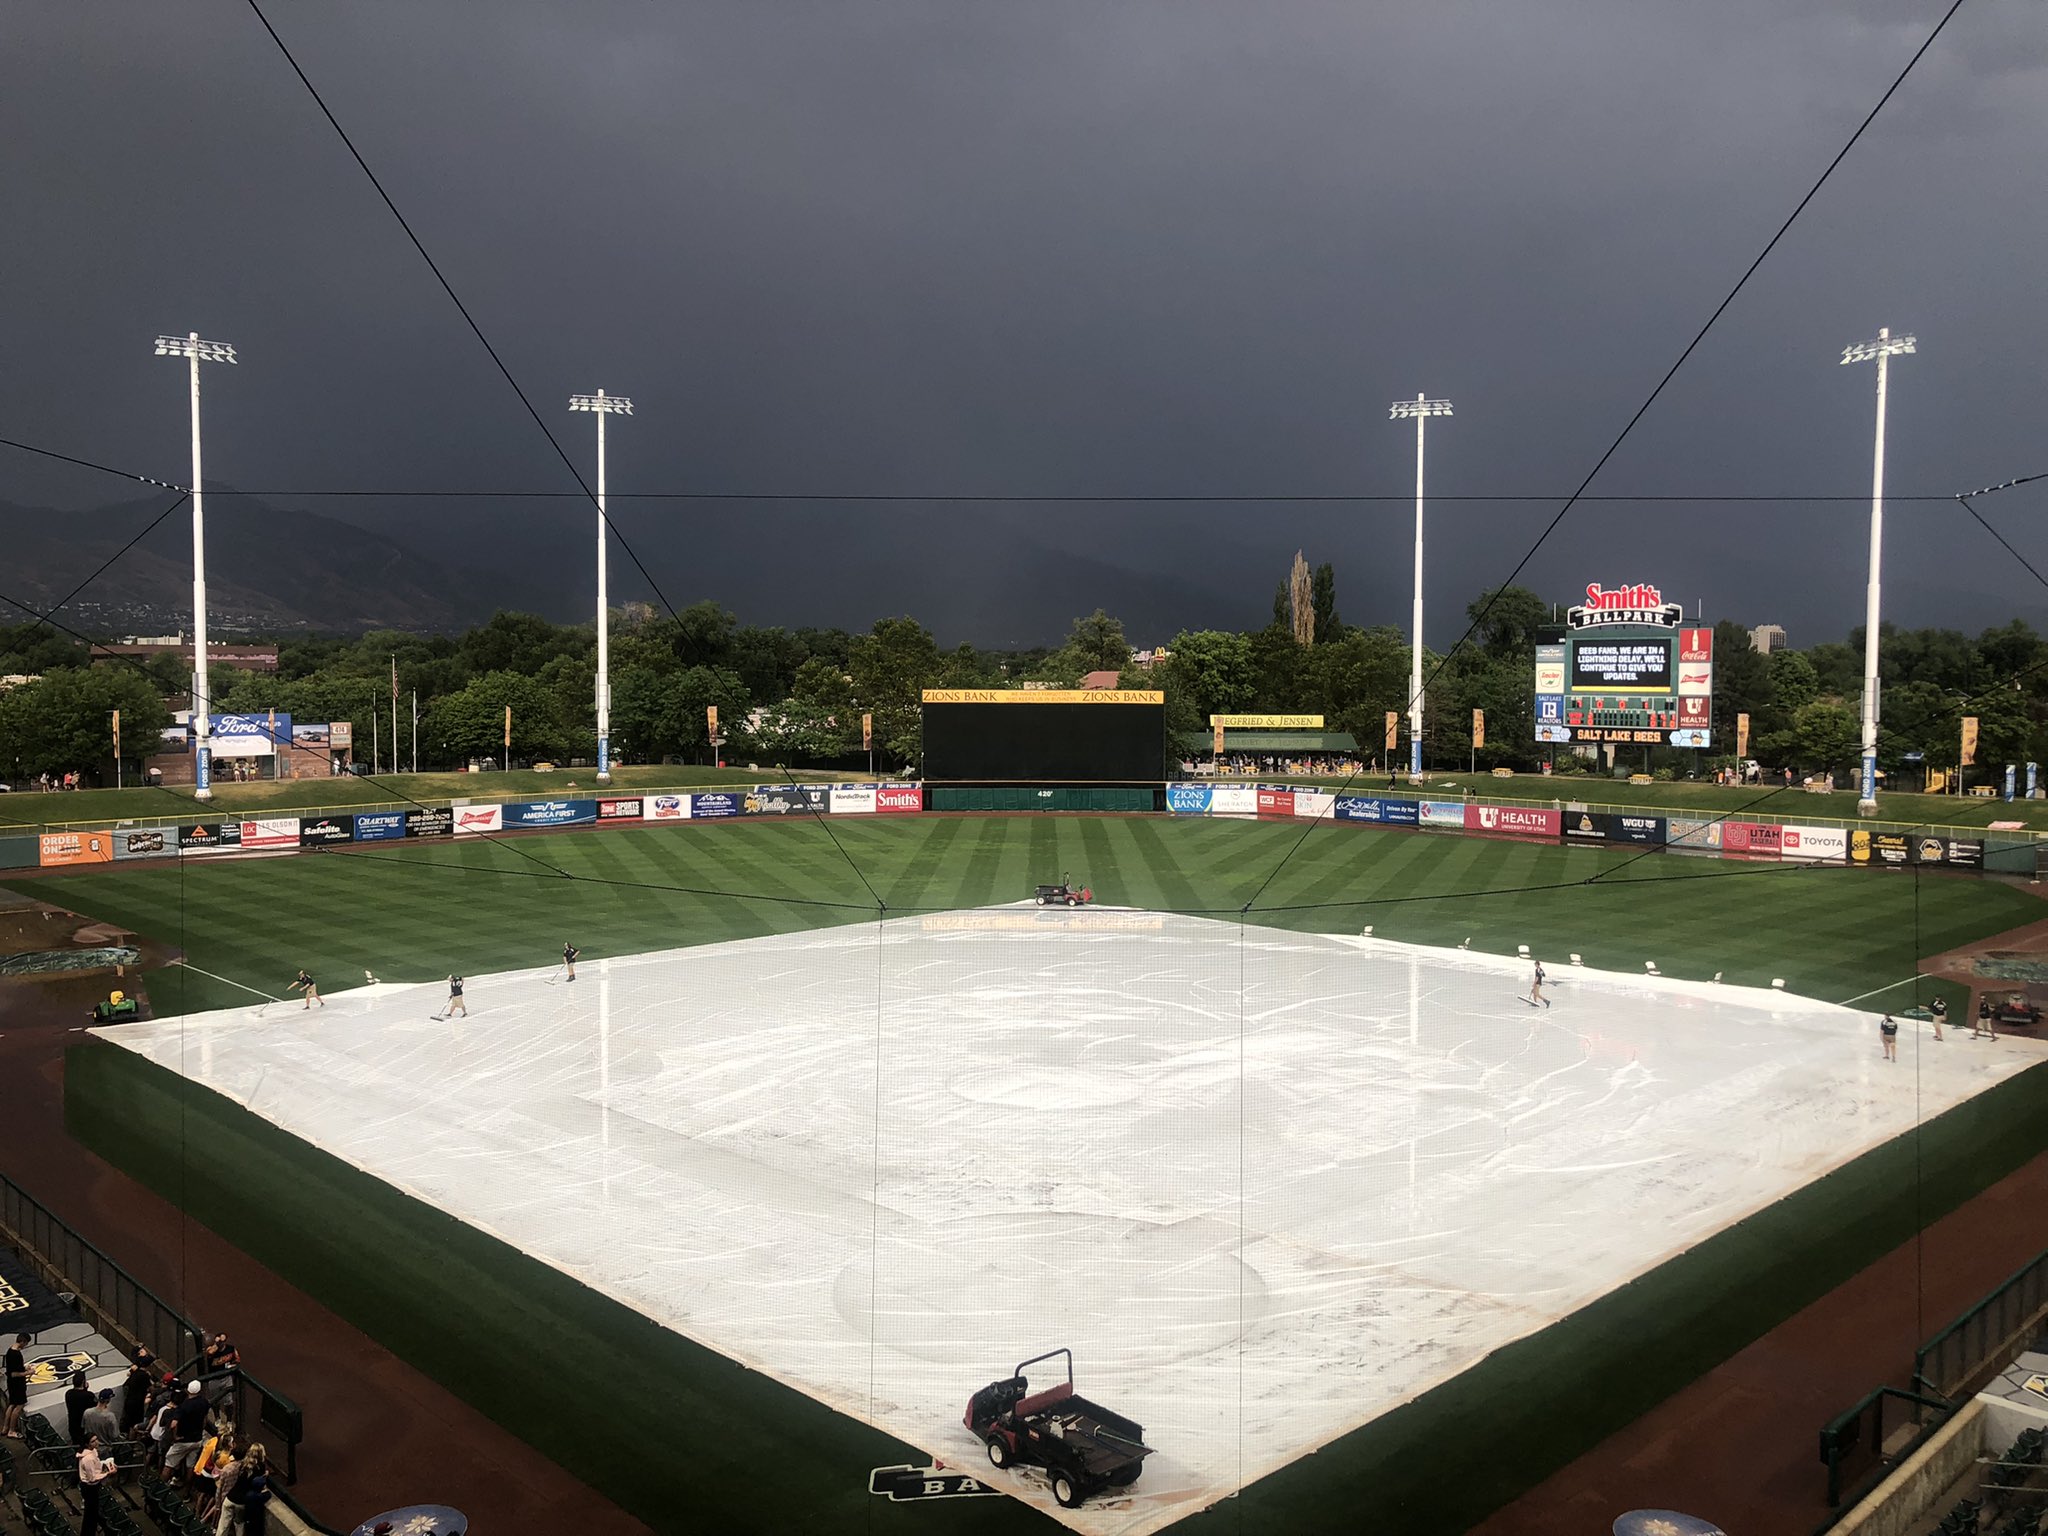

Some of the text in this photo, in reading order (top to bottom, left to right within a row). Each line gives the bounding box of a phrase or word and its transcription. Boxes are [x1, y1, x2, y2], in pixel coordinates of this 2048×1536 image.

[1586, 582, 1661, 609] Smith's
[1583, 611, 1665, 626] BALLPARK
[1620, 647, 1632, 655] WE
[1633, 647, 1647, 655] ARE
[1659, 646, 1665, 655] A
[1644, 655, 1665, 663] WE'LL
[1580, 664, 1663, 672] CONTINUE TO GIVE YOU
[923, 691, 997, 702] ZIONS BANK
[1082, 692, 1157, 702] ZIONS BANK
[217, 716, 261, 733] Ford
[1266, 716, 1275, 725] &
[1279, 716, 1313, 726] JENSEN
[1577, 729, 1662, 742] SALT LAKE BEES
[1862, 760, 1871, 798] FORD ZONE
[877, 793, 919, 807] Smith's
[1174, 791, 1204, 799] ZIONS
[616, 801, 640, 810] SPORTS
[1174, 800, 1204, 809] BANK
[522, 811, 554, 819] AMERICA
[1501, 811, 1546, 826] HEALTH
[358, 815, 401, 826] CHARTWAY
[1622, 818, 1644, 827] WGU
[244, 826, 256, 834] LOC
[304, 826, 340, 836] Safelite
[1750, 829, 1780, 838] UTAH
[42, 835, 78, 846] ORDER
[181, 836, 217, 844] SPECTRUM
[1803, 836, 1844, 847] TOYOTA
